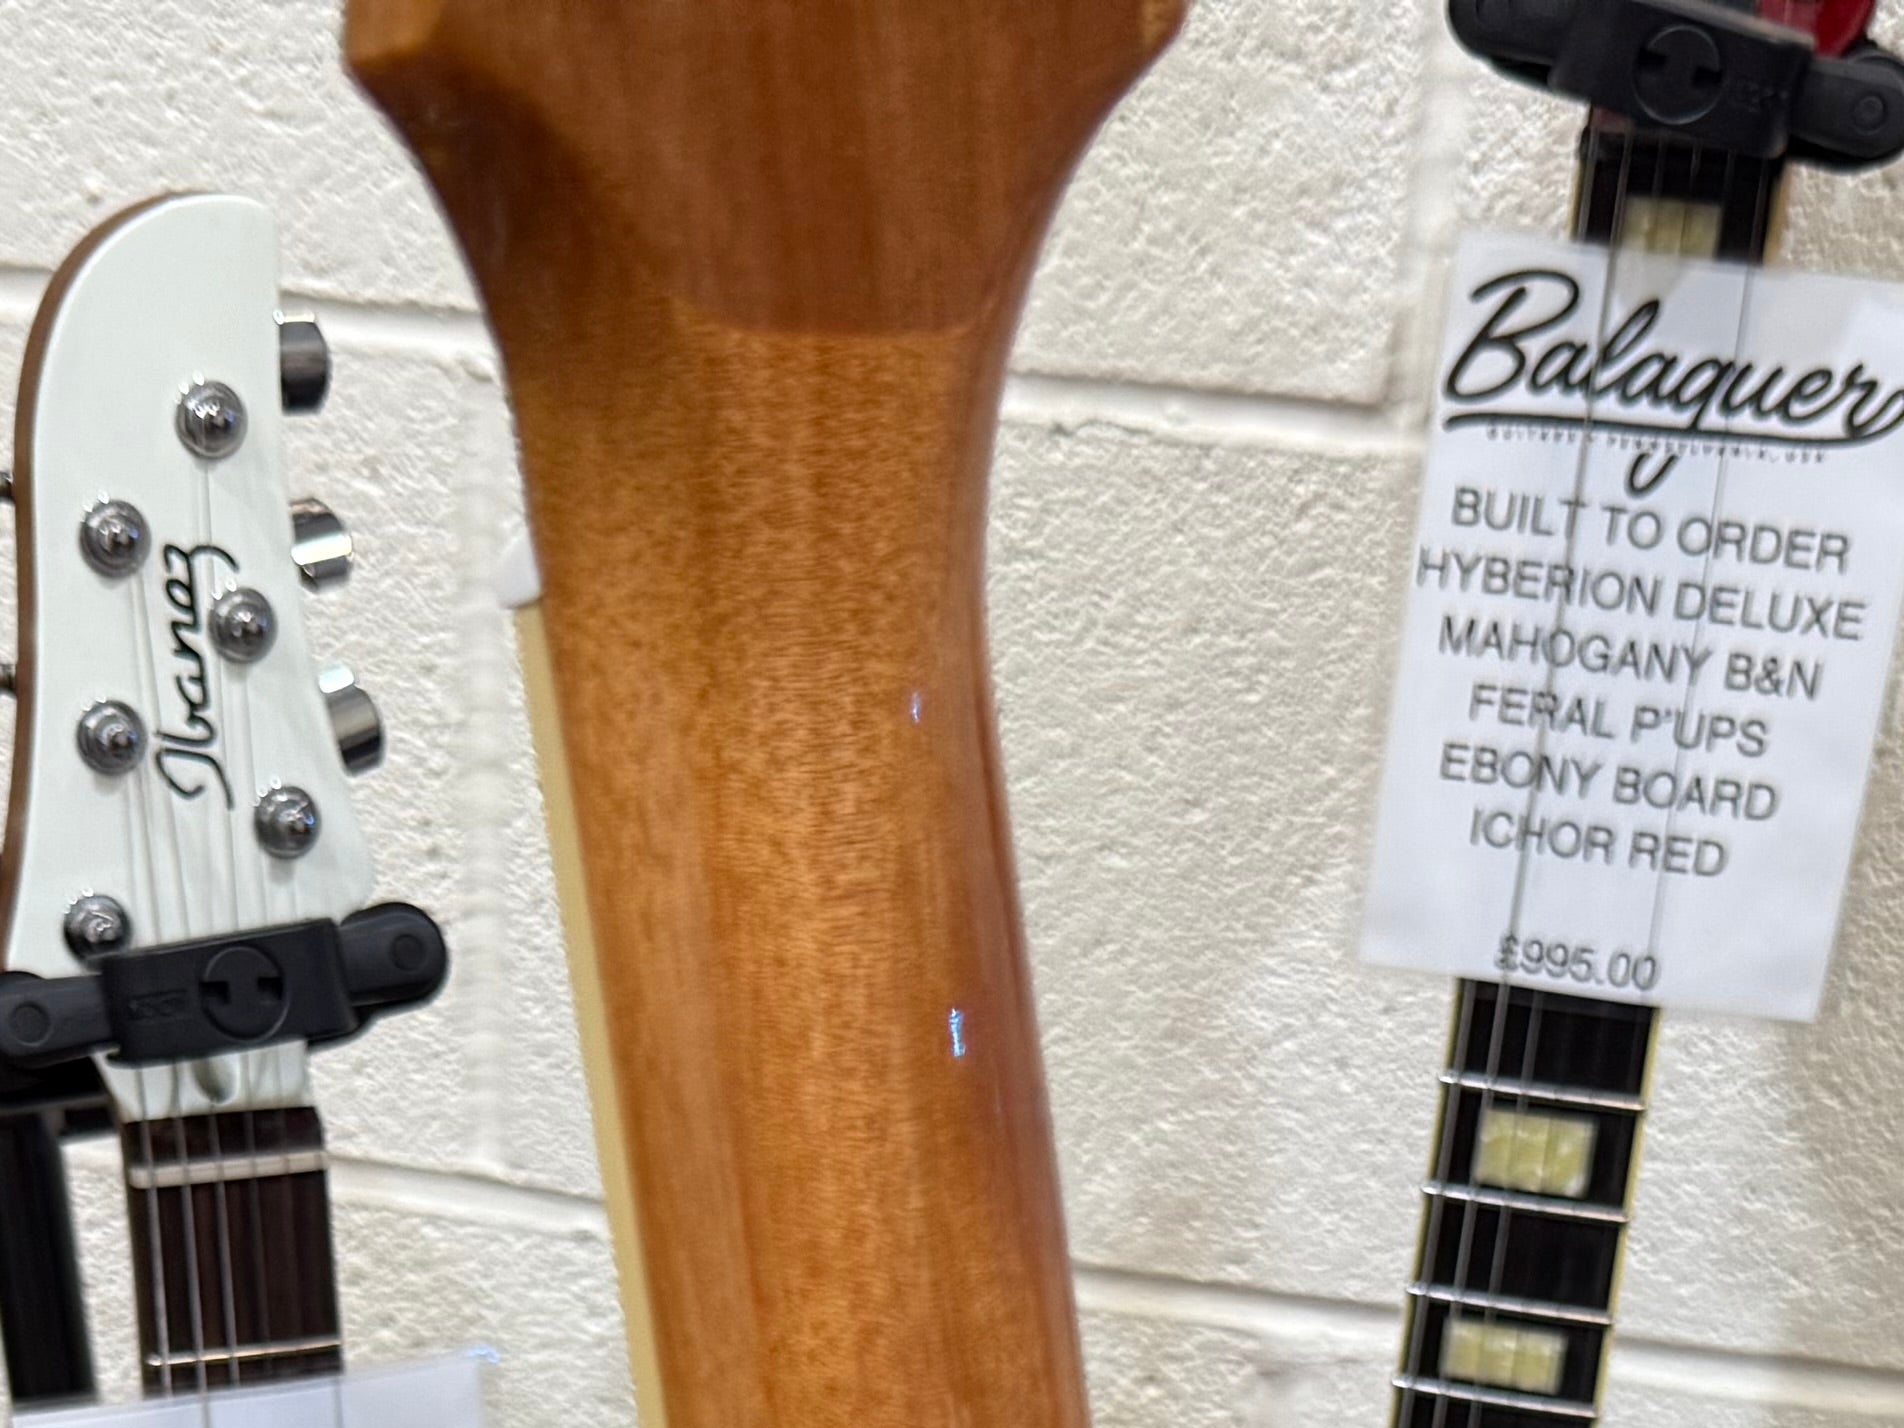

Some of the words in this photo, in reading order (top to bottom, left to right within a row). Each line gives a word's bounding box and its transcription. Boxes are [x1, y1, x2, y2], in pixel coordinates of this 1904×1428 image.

[1451, 486, 1586, 540] BUILT
[1602, 505, 1662, 550] TO
[1676, 512, 1850, 575] ORDER
[1415, 545, 1661, 617] HYBERION
[1675, 580, 1867, 641] DELUXE
[155, 544, 240, 809] Ibanez
[1438, 615, 1713, 684] MAHOGANY
[1725, 653, 1824, 702] B&N
[1468, 683, 1614, 740] FERAL
[1439, 742, 1601, 797] EBONY
[1613, 766, 1779, 821] BOARD
[1471, 809, 1615, 865] ICHOR
[1628, 832, 1728, 878] RED
[1495, 934, 1659, 993] £995.00
